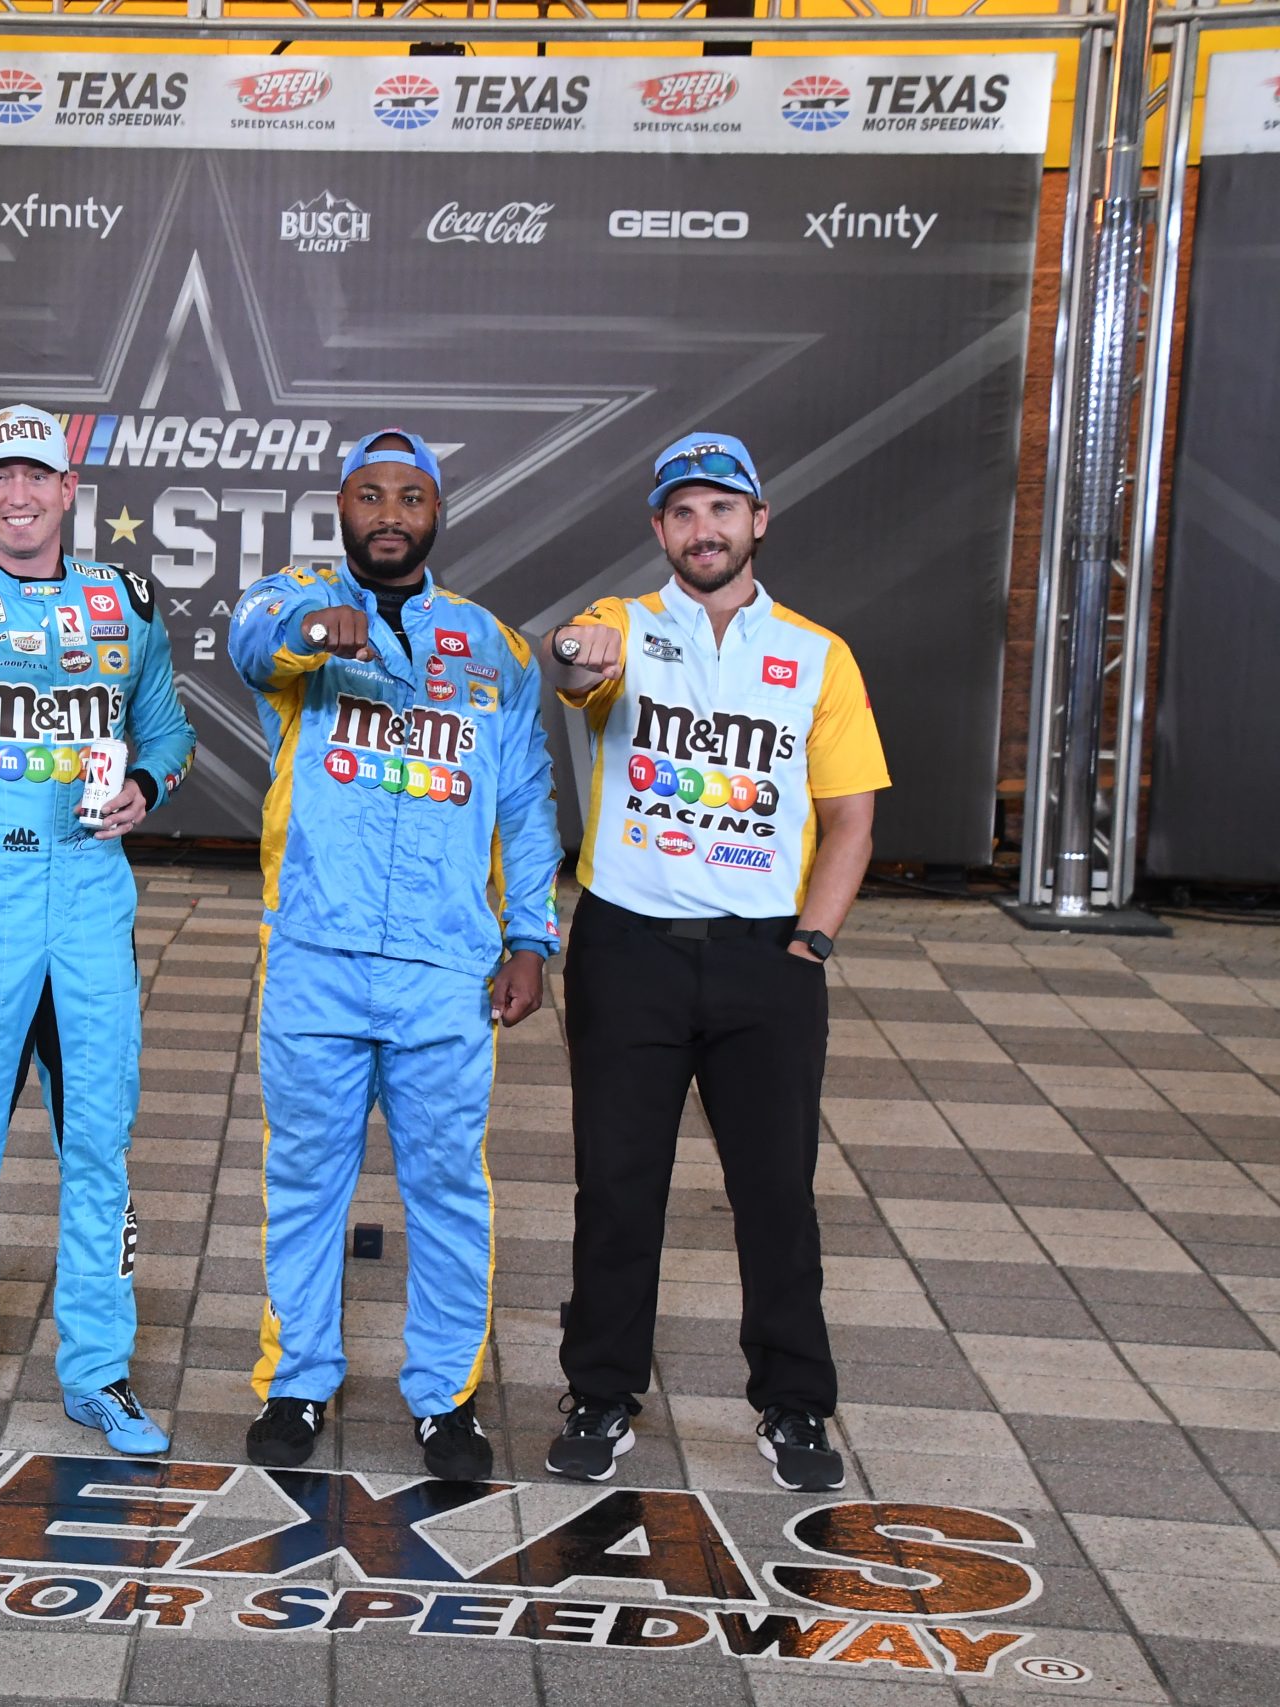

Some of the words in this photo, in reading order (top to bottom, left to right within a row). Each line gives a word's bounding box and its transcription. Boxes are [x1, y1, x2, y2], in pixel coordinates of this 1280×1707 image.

[55, 71, 189, 110] TEXAS
[254, 71, 329, 95] SPEEDY
[453, 74, 591, 114] TEXAS
[658, 72, 733, 97] SPEEDY
[866, 74, 1010, 114] TEXAS
[55, 111, 105, 126] MOTOR
[108, 111, 182, 128] SPEEDWAY
[230, 118, 336, 131] SPEEDYCASH.COM
[451, 117, 503, 131] MOTOR
[506, 117, 583, 131] SPEEDWAY
[632, 120, 742, 133] SPEEDYCASH.COM
[862, 117, 917, 132] MOTOR
[920, 117, 1001, 132] SPEEDWAY
[0, 193, 123, 239] xfinity
[279, 210, 371, 242] BUSCH
[608, 210, 749, 239] GEICO
[804, 203, 938, 249] xfinity
[297, 239, 350, 253] LIGHT
[106, 417, 332, 472] NASCAR
[92, 625, 125, 635] SNICKERS
[61, 655, 91, 668] Skittles
[627, 794, 777, 838] RACING
[3, 827, 40, 846] MAC
[658, 838, 694, 851] Skittles
[231, 1584, 1035, 1678] SPEEDWAY
